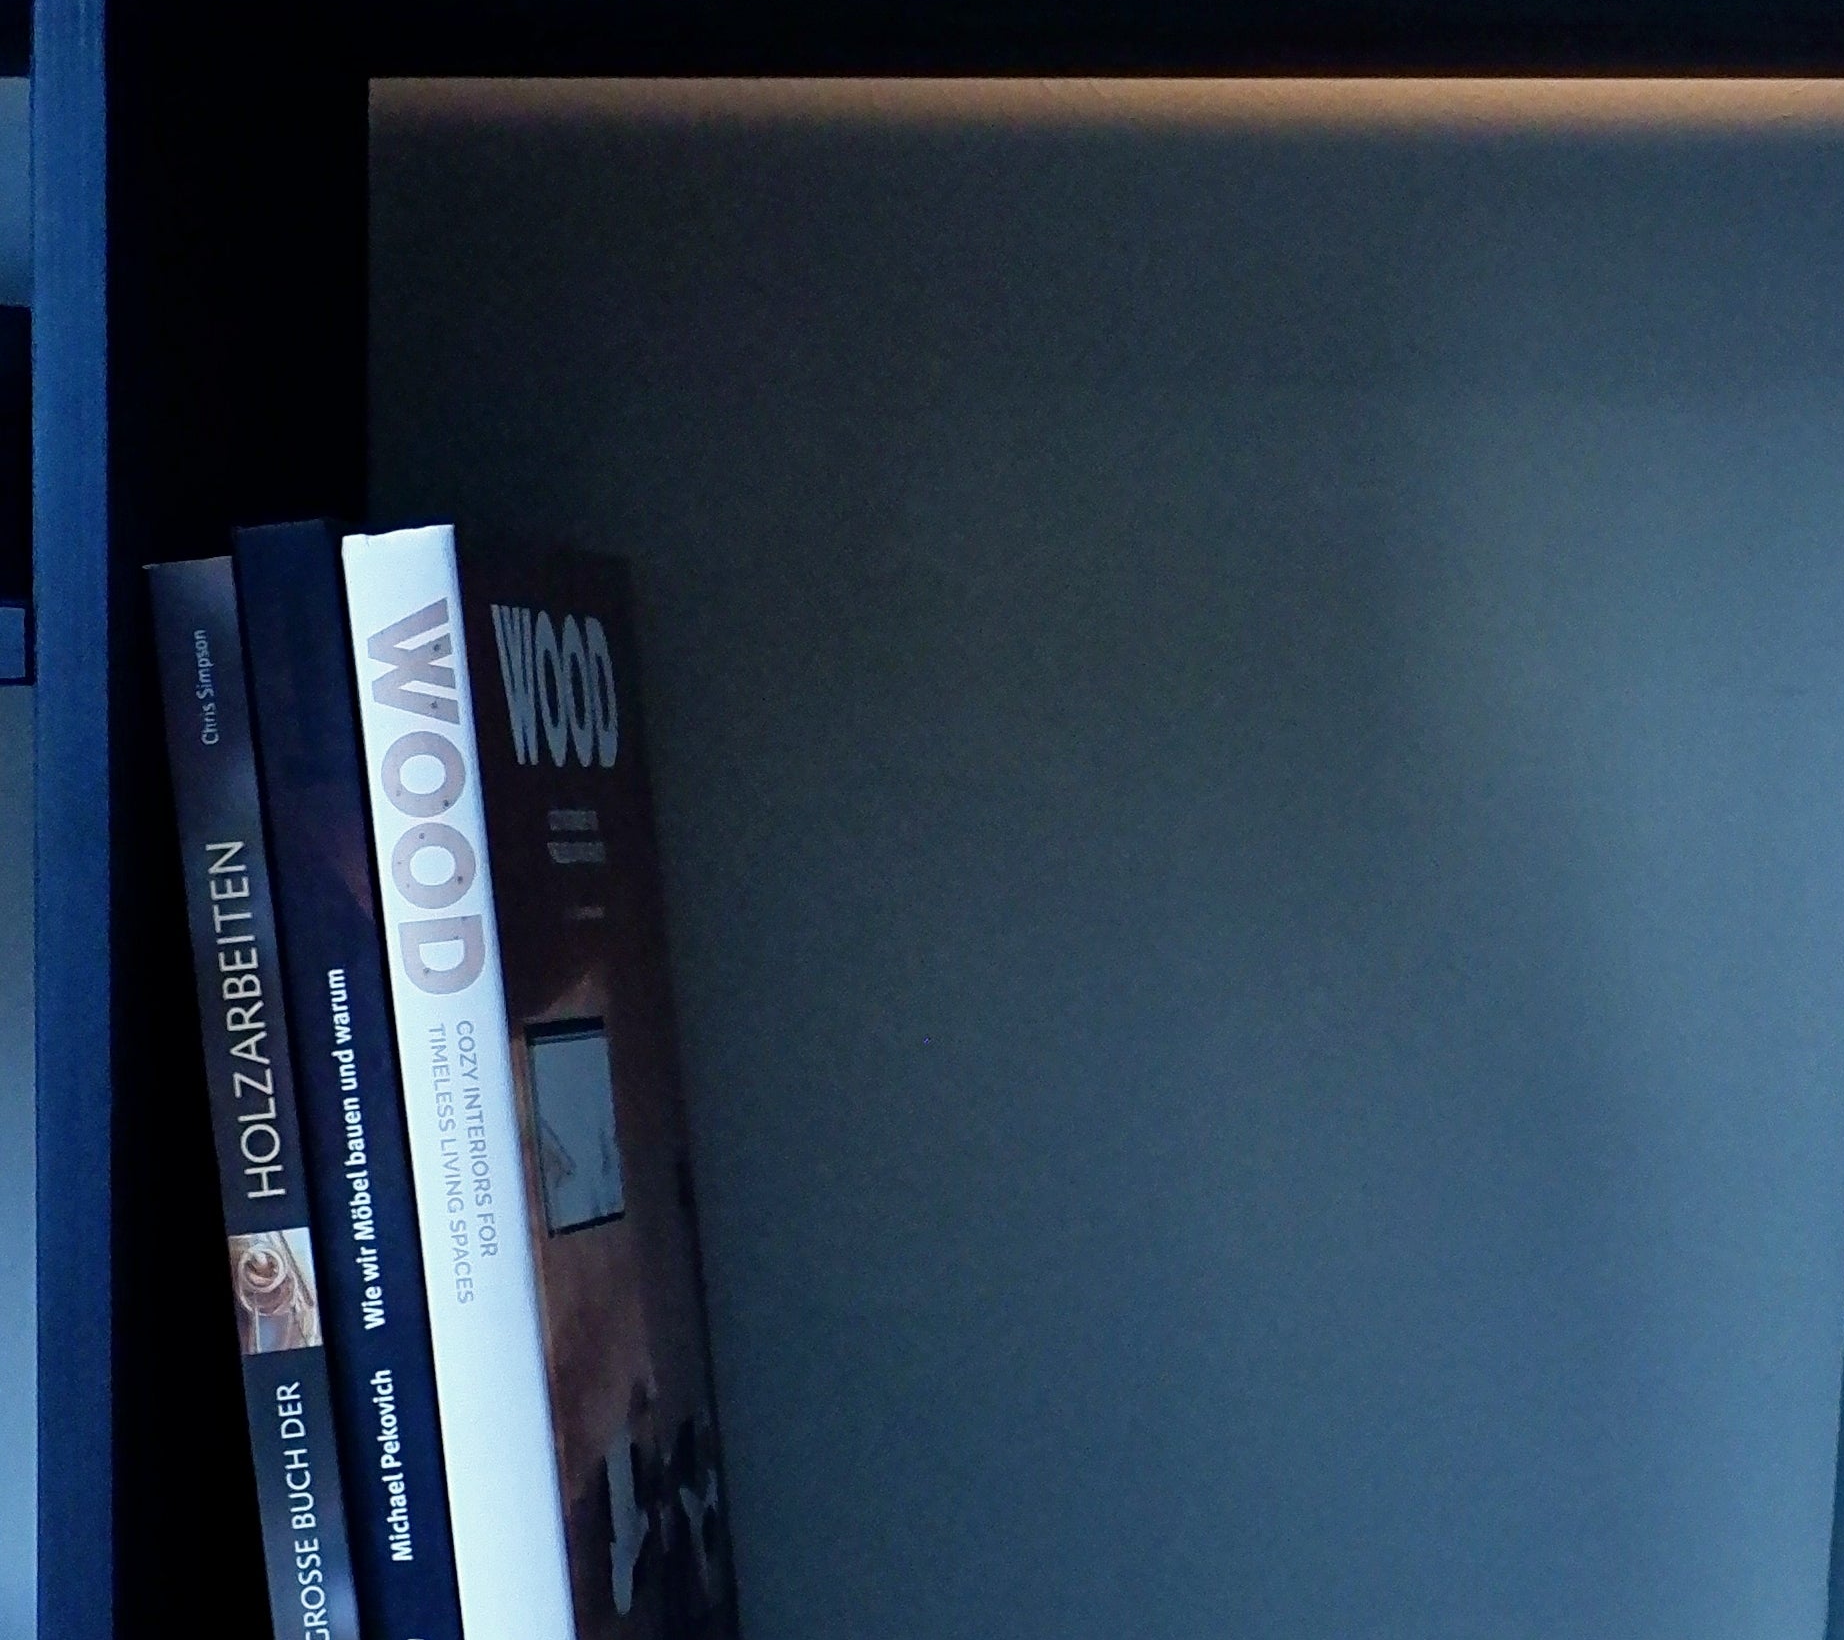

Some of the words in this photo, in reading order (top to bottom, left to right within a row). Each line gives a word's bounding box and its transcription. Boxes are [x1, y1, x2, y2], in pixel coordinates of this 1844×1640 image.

[193, 628, 214, 700] Simpson
[491, 603, 618, 768] WOOD
[201, 702, 219, 745] Chris
[367, 596, 486, 995] WOOD
[205, 840, 287, 1200] HOLZARBEITEN
[327, 968, 352, 1045] warum
[331, 1049, 358, 1092] und
[429, 1023, 456, 1132] TIMELESS
[456, 1020, 479, 1081] COZY
[343, 1097, 367, 1166] bauen
[463, 1087, 493, 1207] INTERIORS
[345, 1169, 376, 1241] Möbel
[441, 1138, 464, 1213] LIVING
[356, 1246, 380, 1282] wir
[449, 1220, 474, 1304] SPACES
[477, 1213, 499, 1257] FOR
[361, 1286, 386, 1330] Wie
[276, 1381, 306, 1439] DER
[370, 1369, 402, 1469] Pekovich
[283, 1448, 317, 1529] BUCH
[381, 1472, 414, 1561] Michael
